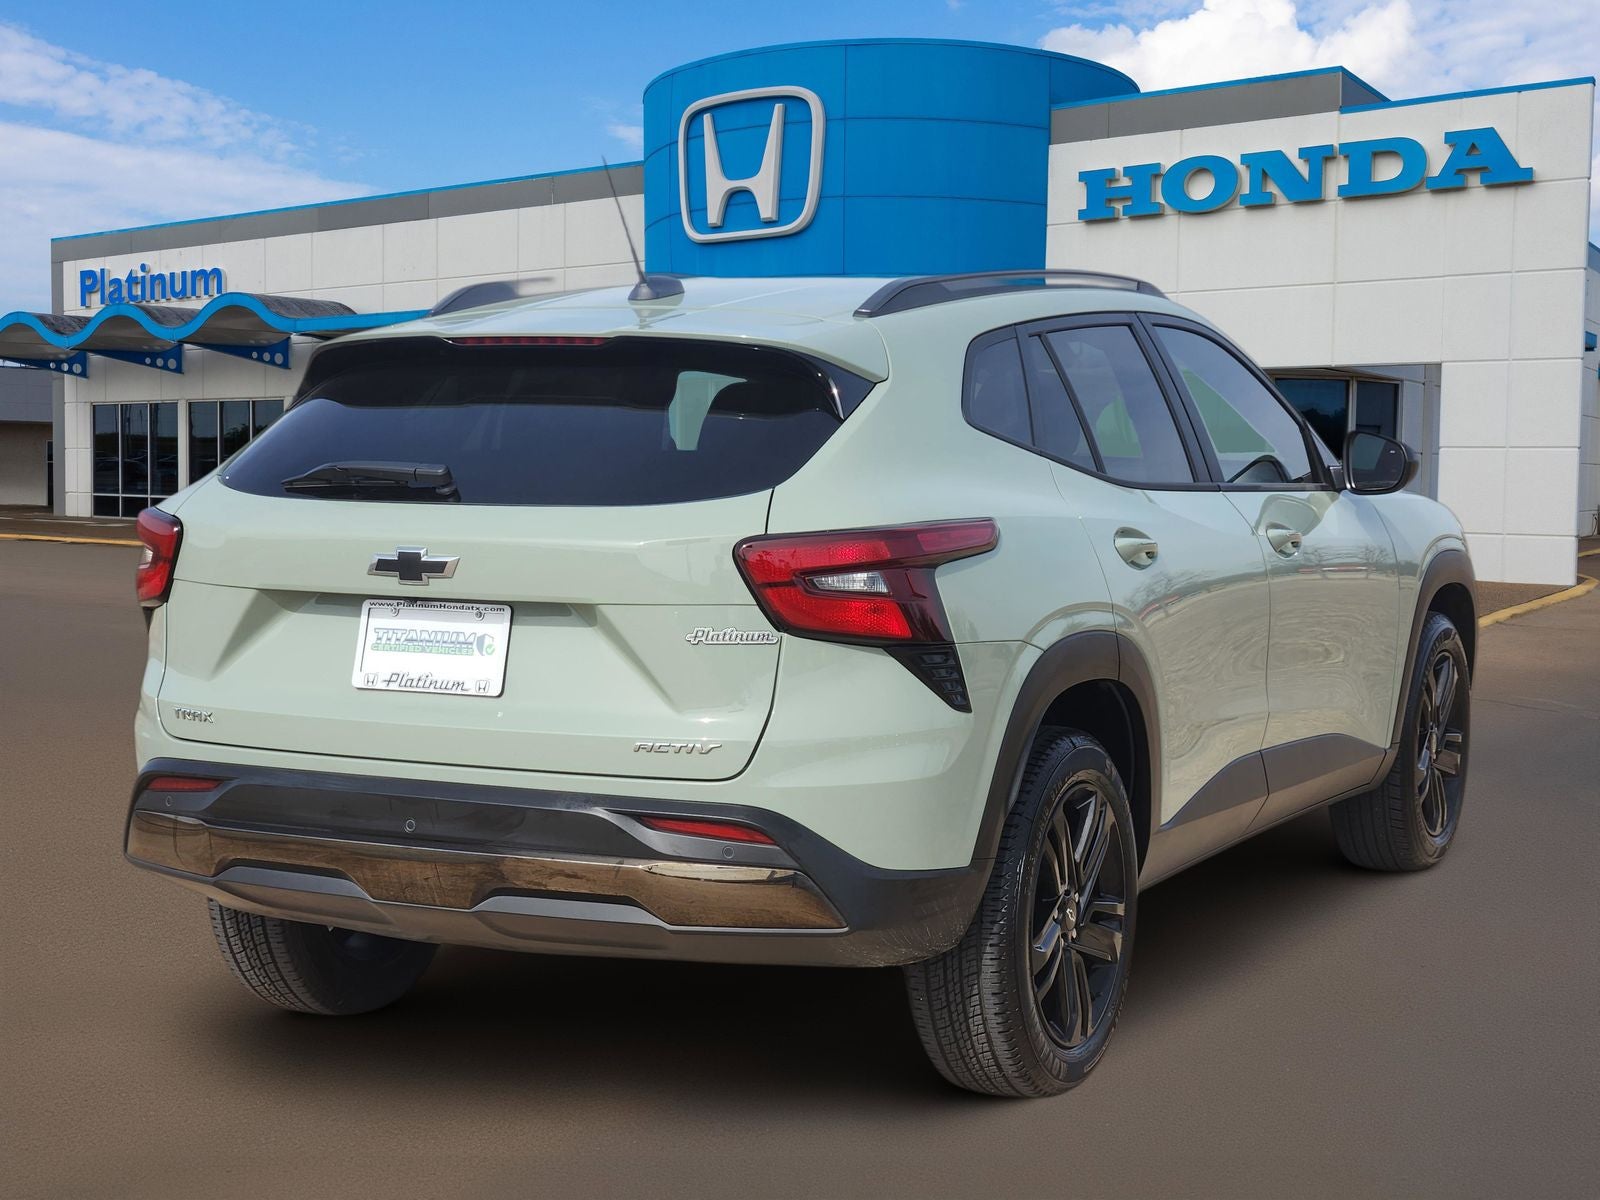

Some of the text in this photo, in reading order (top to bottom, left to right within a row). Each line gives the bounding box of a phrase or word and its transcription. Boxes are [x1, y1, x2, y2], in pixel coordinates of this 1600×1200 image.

[1078, 126, 1534, 222] HONDA
[80, 263, 225, 308] Platinum
[369, 601, 505, 612] www.PlatinumHondatx.com
[374, 627, 477, 645] TITANIUM
[686, 627, 779, 645] Platinum
[370, 642, 475, 656] CERTIFIED VEHICLES
[382, 671, 471, 693] Platinum
[174, 707, 214, 723] TRAX
[633, 742, 722, 754] ACTIV
